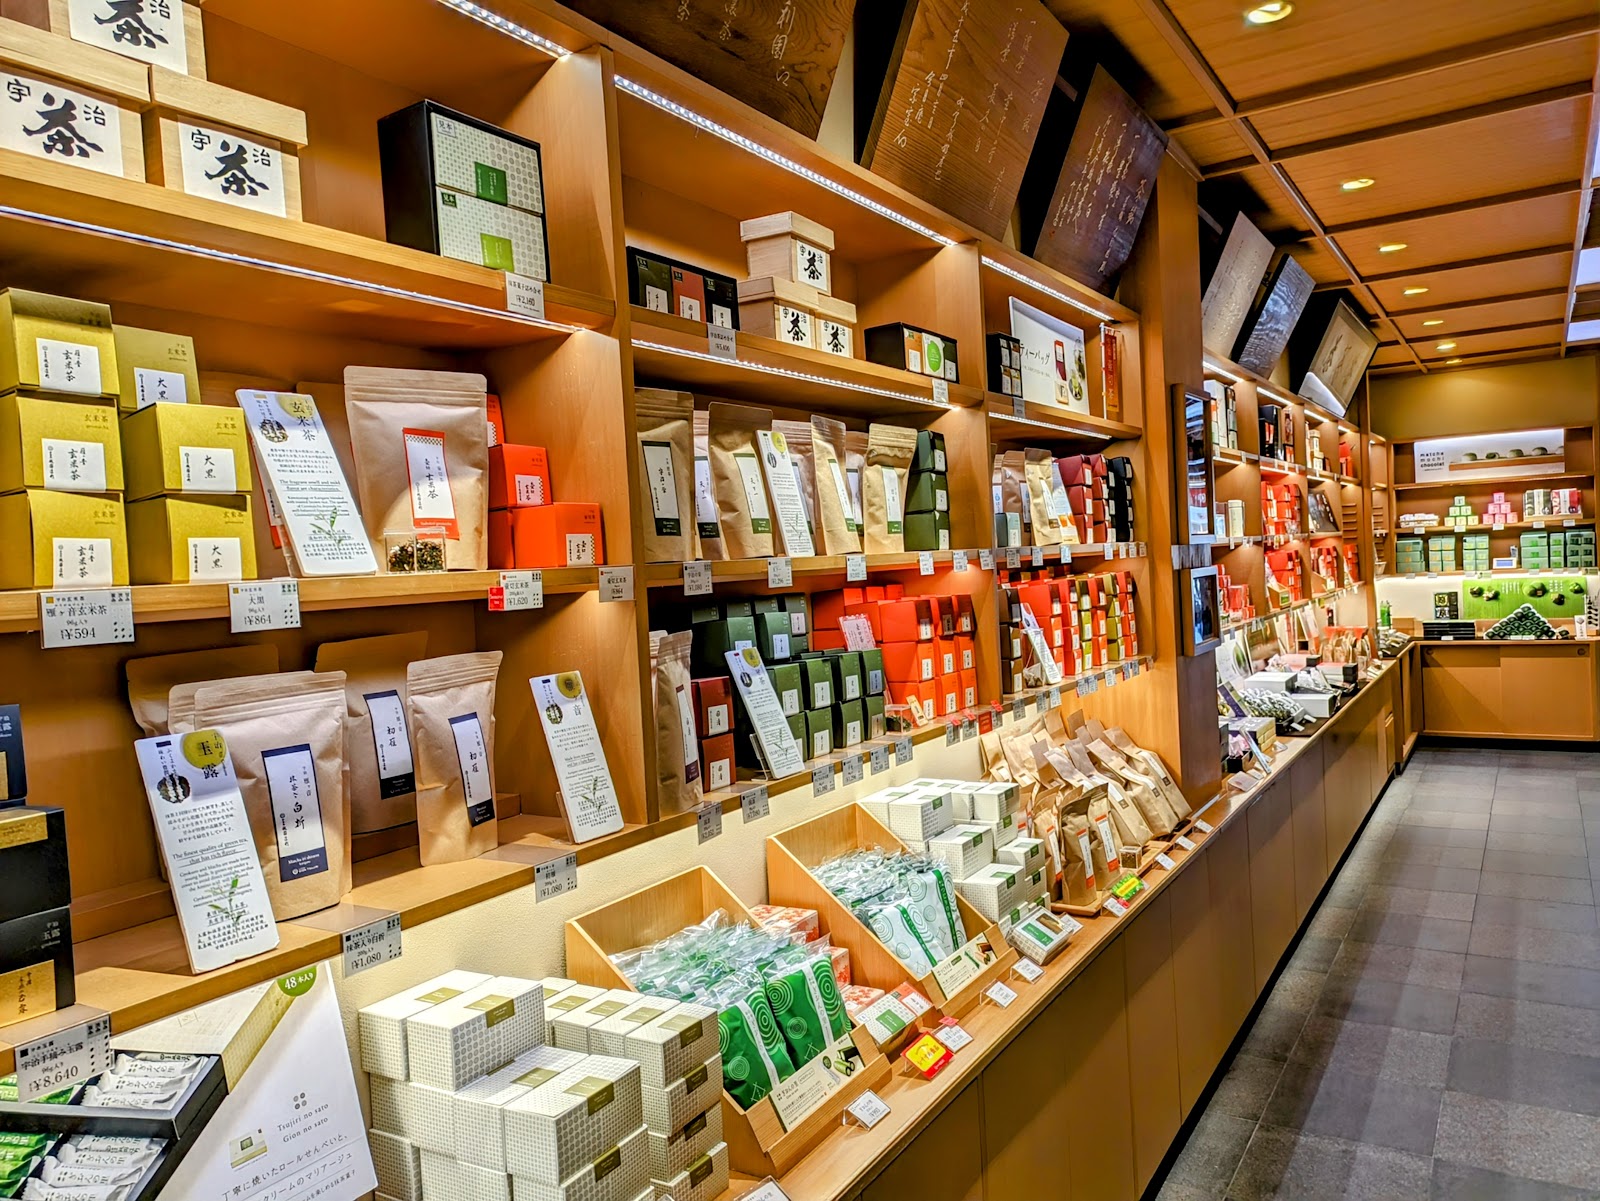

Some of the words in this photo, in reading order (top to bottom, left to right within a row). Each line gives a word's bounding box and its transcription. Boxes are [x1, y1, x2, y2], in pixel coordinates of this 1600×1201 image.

[22, 91, 104, 159] 茶
[204, 140, 270, 197] 茶
[803, 250, 823, 280] 茶
[787, 311, 806, 341] 茶
[827, 325, 845, 353] 茶
[290, 401, 316, 441] 玄米茶
[248, 595, 265, 605] 大黒
[198, 740, 219, 779] 玉露
[277, 1116, 302, 1132] Tsujiri
[303, 1110, 313, 1120] no
[314, 1103, 329, 1114] sato
[282, 1131, 301, 1143] Gion
[303, 1124, 313, 1133] no
[314, 1117, 329, 1128] sato
